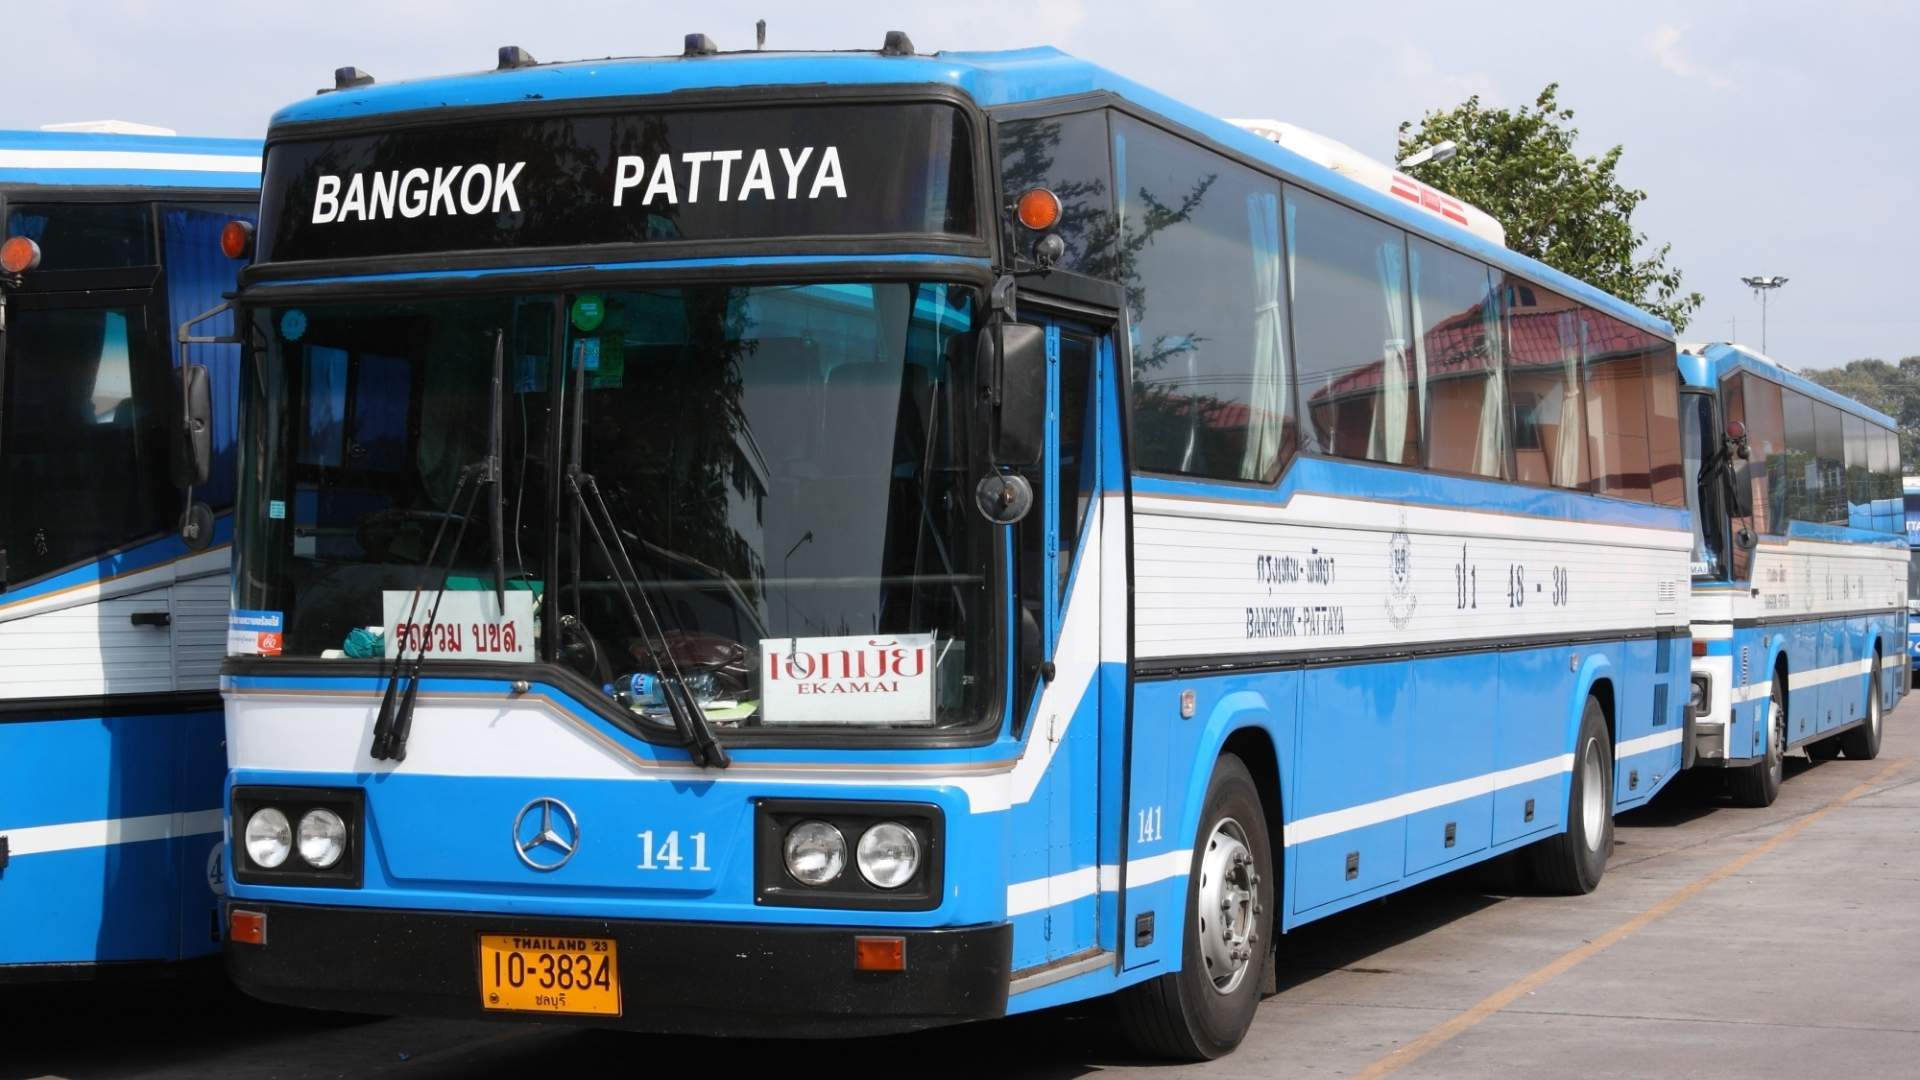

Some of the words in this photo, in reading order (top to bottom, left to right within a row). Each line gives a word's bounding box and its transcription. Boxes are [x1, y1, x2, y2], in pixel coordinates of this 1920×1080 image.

[312, 161, 526, 224] BANGKOK
[612, 146, 848, 207] PATTAYA
[1506, 563, 1524, 608] 48
[1552, 565, 1567, 607] 30
[769, 639, 926, 681] เอกมัย
[798, 681, 899, 695] EKAMAI
[1137, 805, 1163, 844] 141
[636, 830, 711, 871] 141
[512, 938, 586, 951] THAILAND
[495, 951, 610, 991] 10-3834
